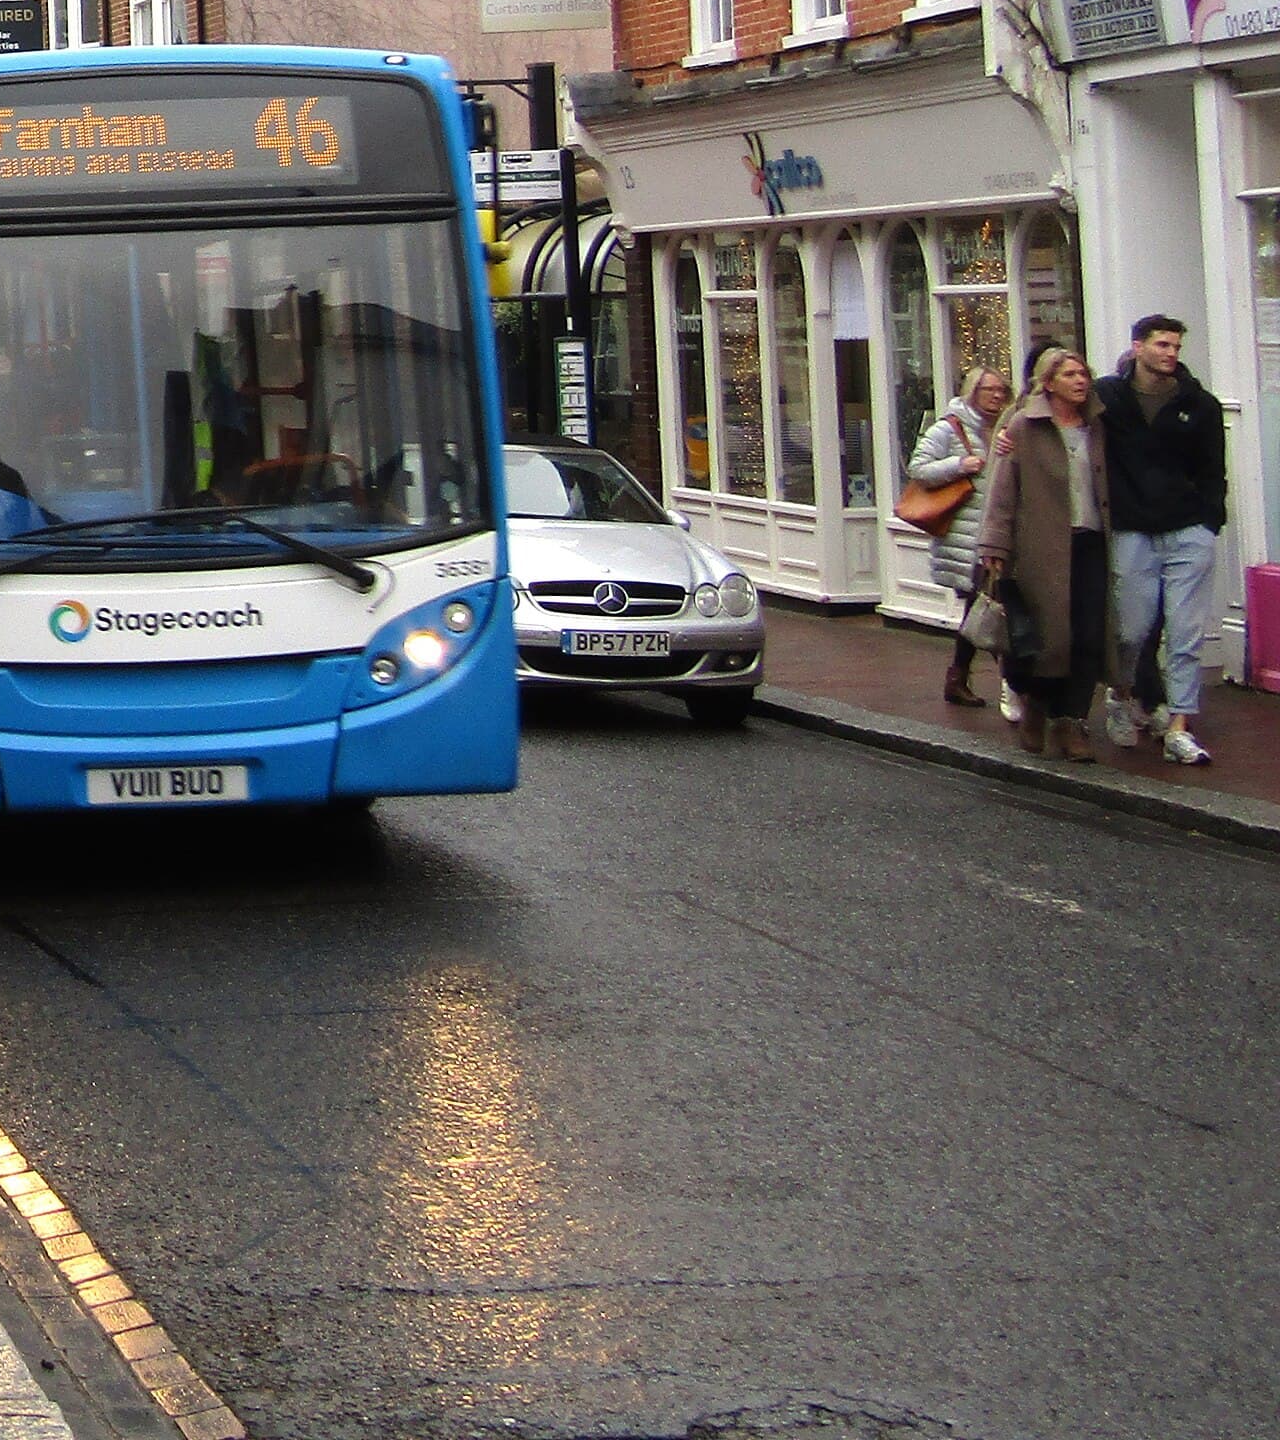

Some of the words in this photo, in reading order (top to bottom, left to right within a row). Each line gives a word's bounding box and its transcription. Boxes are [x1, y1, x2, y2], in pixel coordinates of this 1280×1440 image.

[255, 96, 339, 167] 46
[85, 153, 130, 174] and
[95, 602, 262, 636] Stagecoach
[576, 633, 626, 651] BP57
[633, 633, 668, 652] PZH
[110, 770, 161, 797] VU11
[170, 769, 223, 796] BUO
